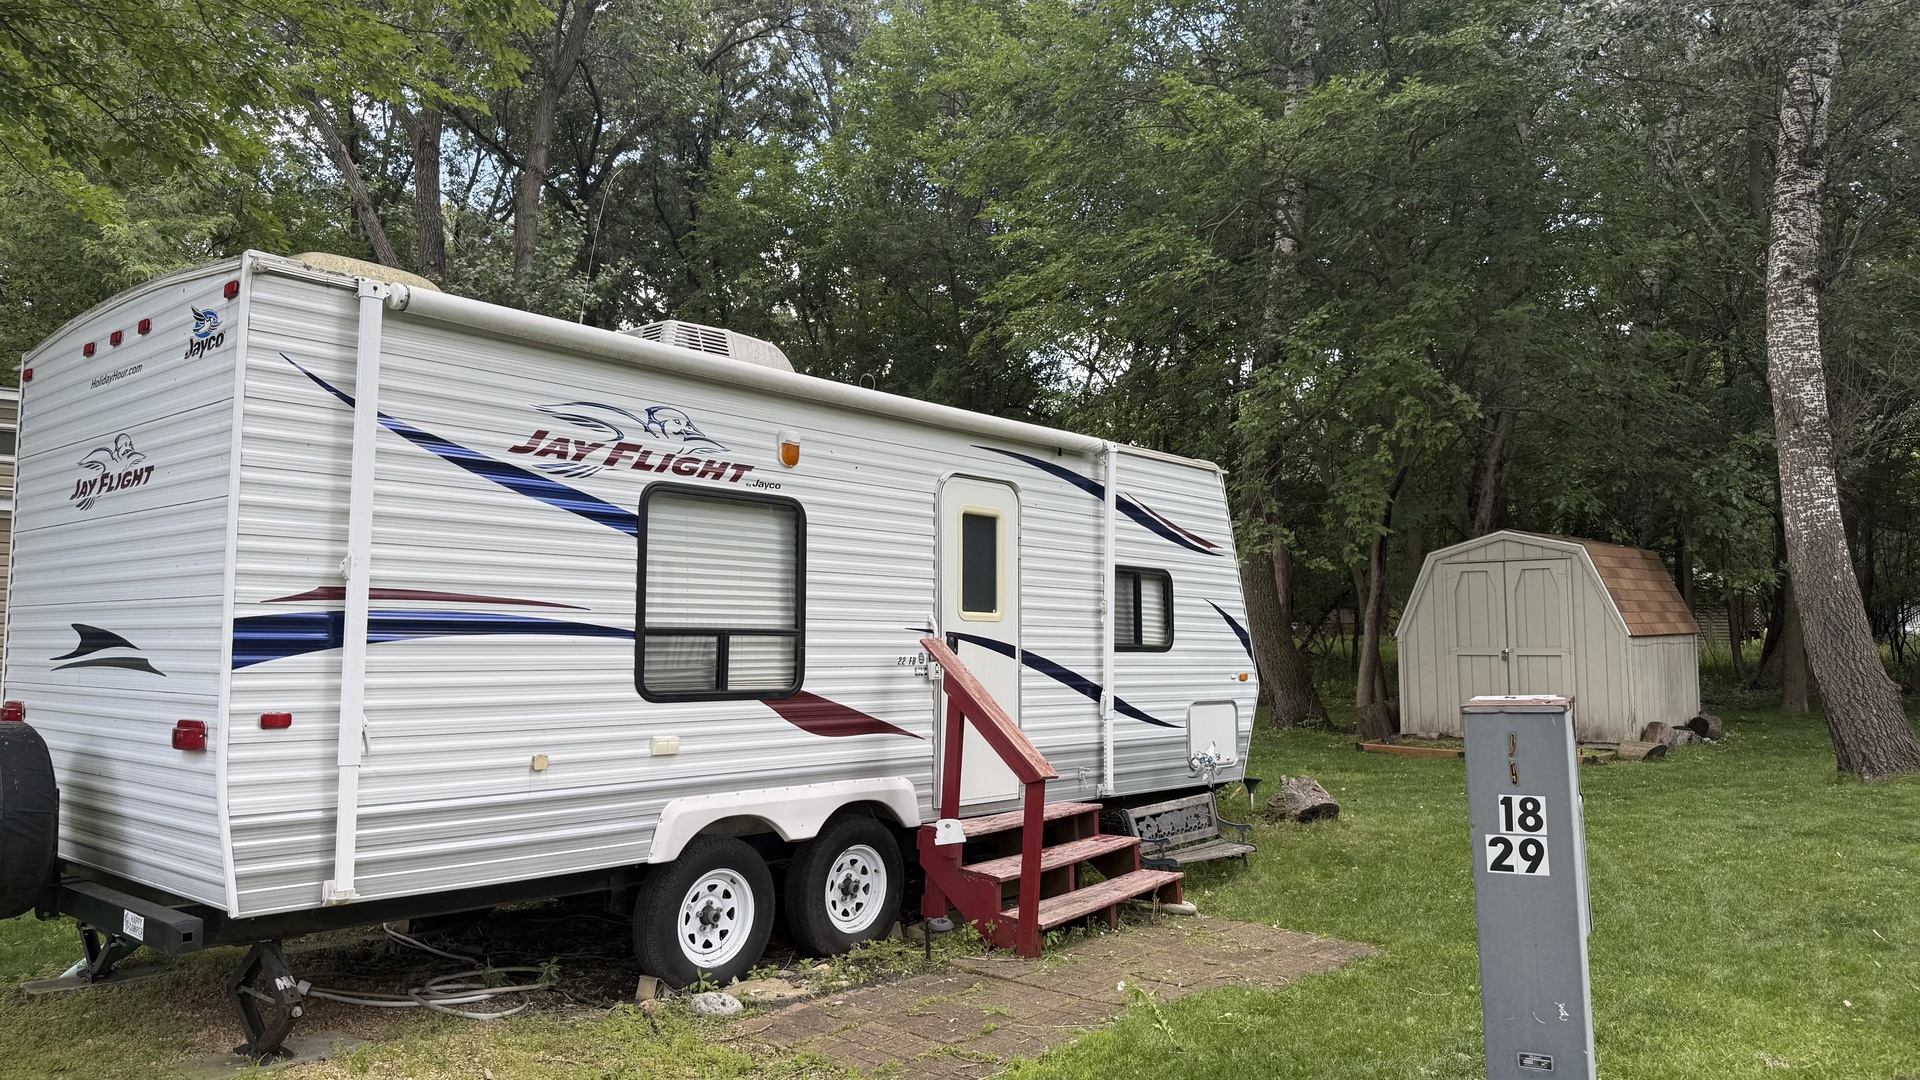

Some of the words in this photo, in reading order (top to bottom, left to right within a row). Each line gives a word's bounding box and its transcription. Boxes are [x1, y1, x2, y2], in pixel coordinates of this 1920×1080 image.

[184, 332, 225, 359] Jayco
[90, 364, 143, 390] HolidayHour.com
[508, 429, 606, 462] JAY
[602, 441, 755, 483] FLIGHT
[69, 478, 98, 500] JAY
[96, 465, 155, 495] FLIGHT
[752, 479, 781, 490] Jayco
[898, 656, 906, 665] 22
[1500, 796, 1544, 832] 18
[1488, 836, 1545, 873] 29
